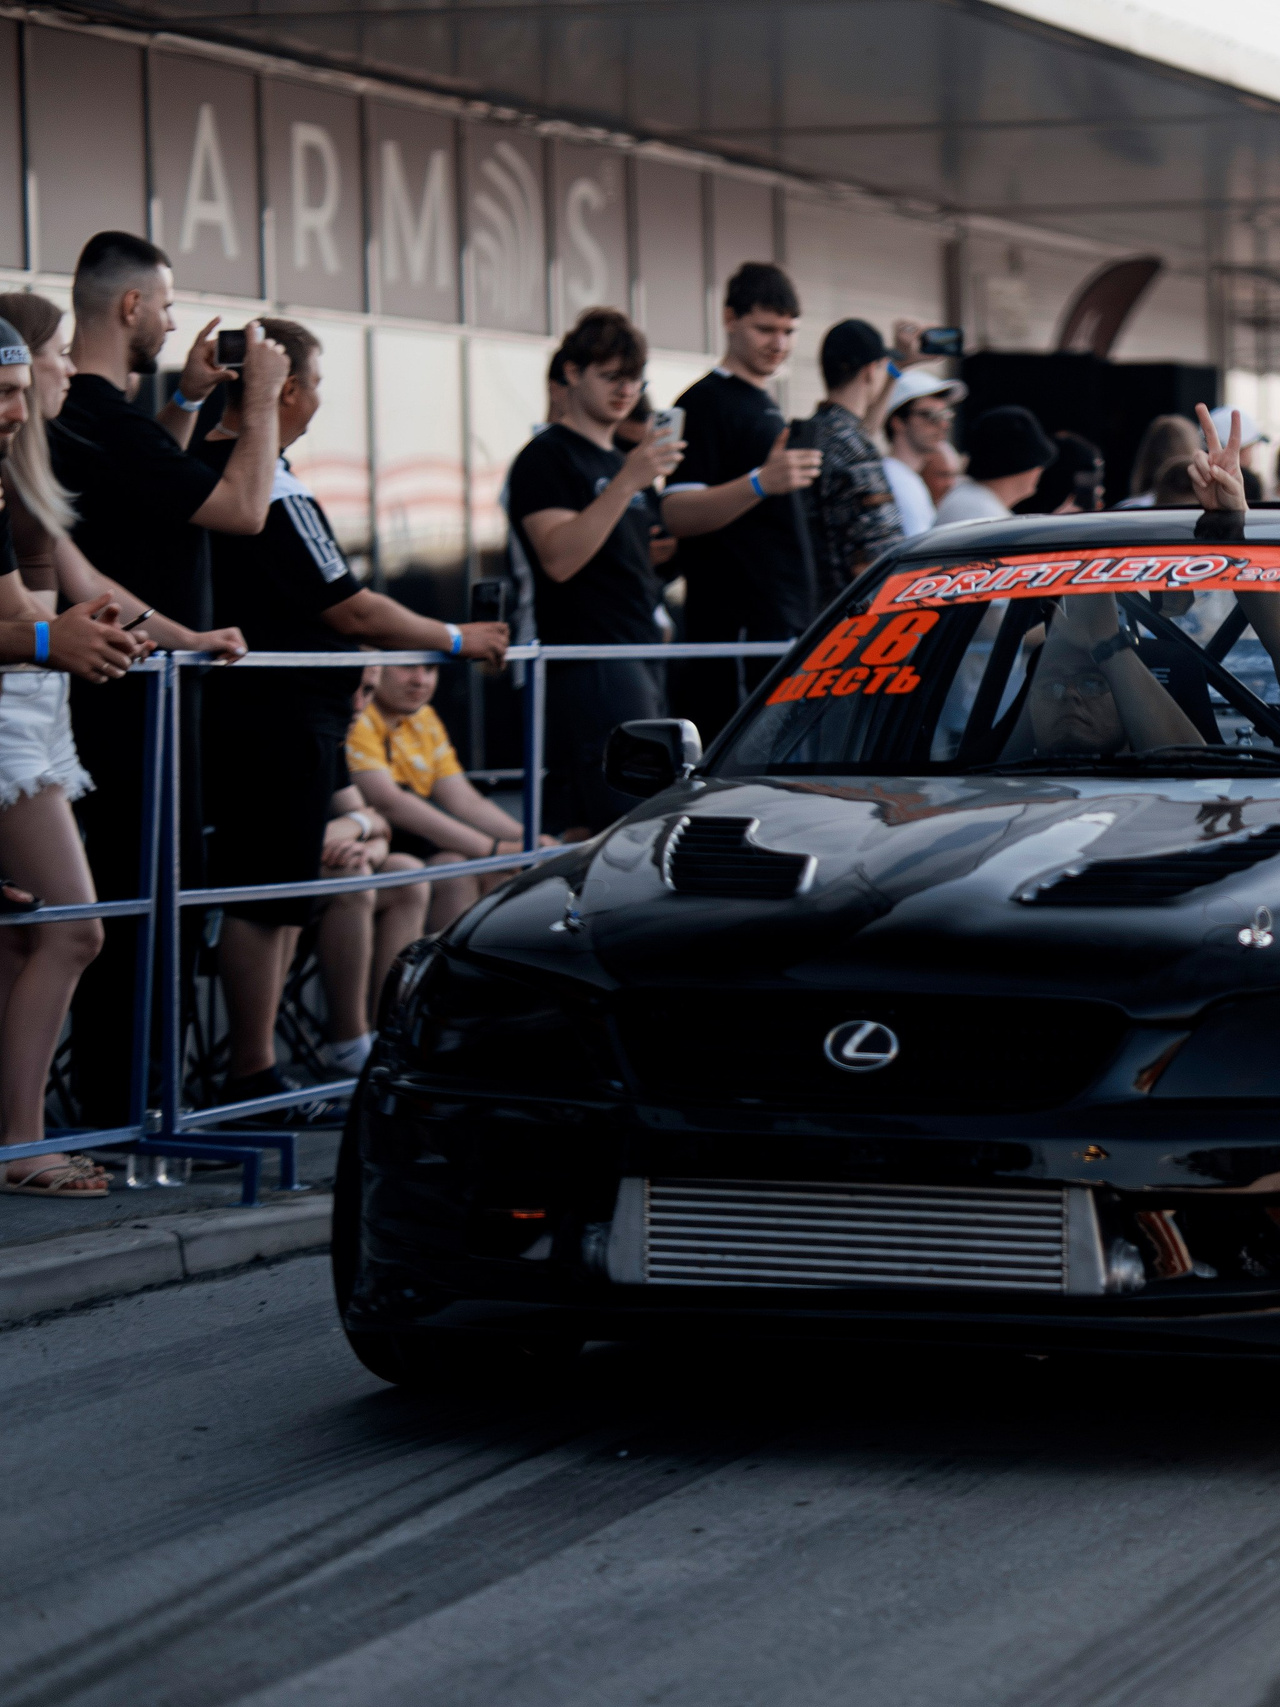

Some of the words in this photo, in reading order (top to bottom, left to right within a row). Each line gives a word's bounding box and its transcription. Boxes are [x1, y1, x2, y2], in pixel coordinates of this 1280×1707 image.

[895, 559, 1082, 603] DRIFT
[1071, 555, 1231, 584] LETO
[801, 609, 940, 671] 66
[765, 665, 922, 706] ШЕСТЬ
